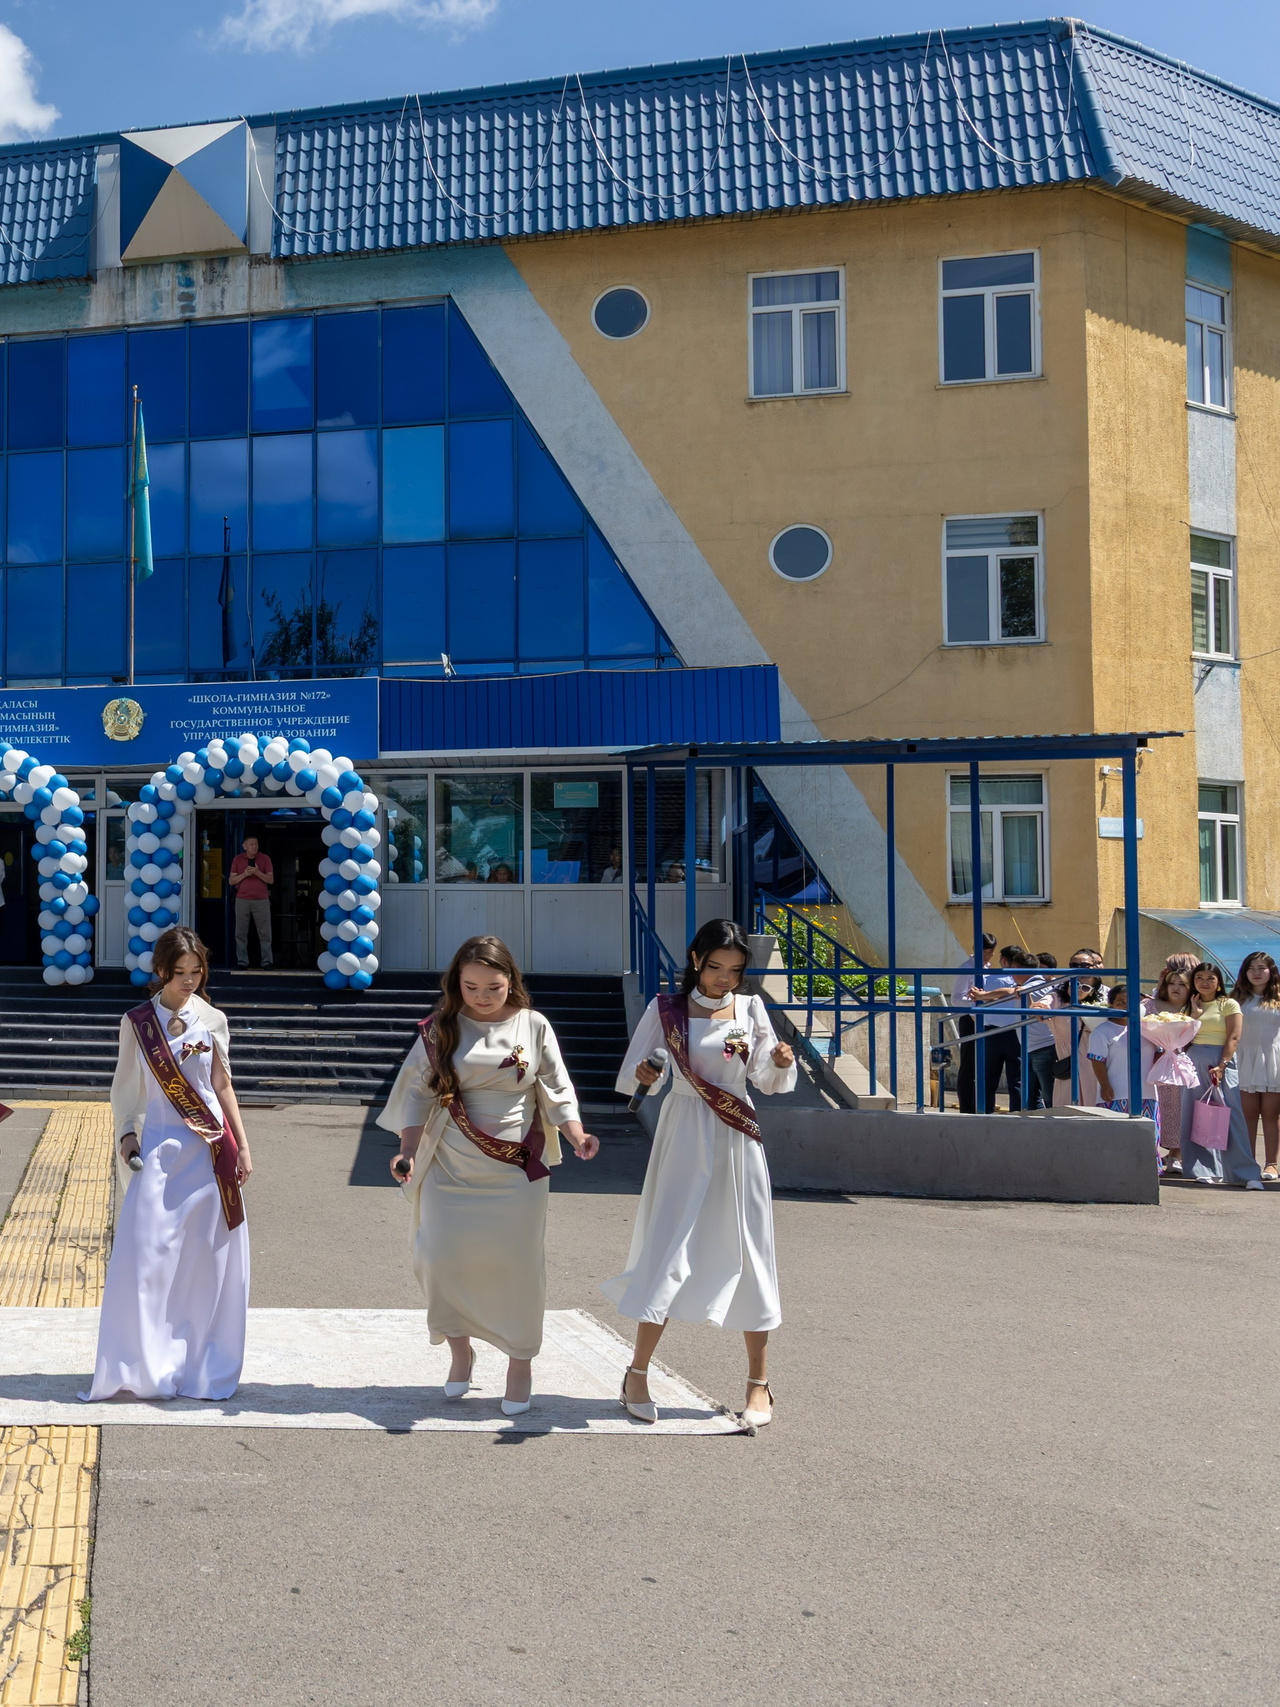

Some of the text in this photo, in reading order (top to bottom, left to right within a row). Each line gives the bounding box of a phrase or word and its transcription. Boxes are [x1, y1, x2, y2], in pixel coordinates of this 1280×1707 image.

[188, 691, 331, 703] «ШКОЛА-ГИМНАЗИЯ №172»
[212, 704, 306, 716] КОММУНАЛЬНОЕ
[170, 715, 351, 730] ГОСУДАРСТВЕННОЕ УЧРЕЖДЕНИЕ
[0, 735, 71, 745] МЕМЛЕКЕТТІК
[256, 728, 337, 740] ОБРАЗОВАНИЯ
